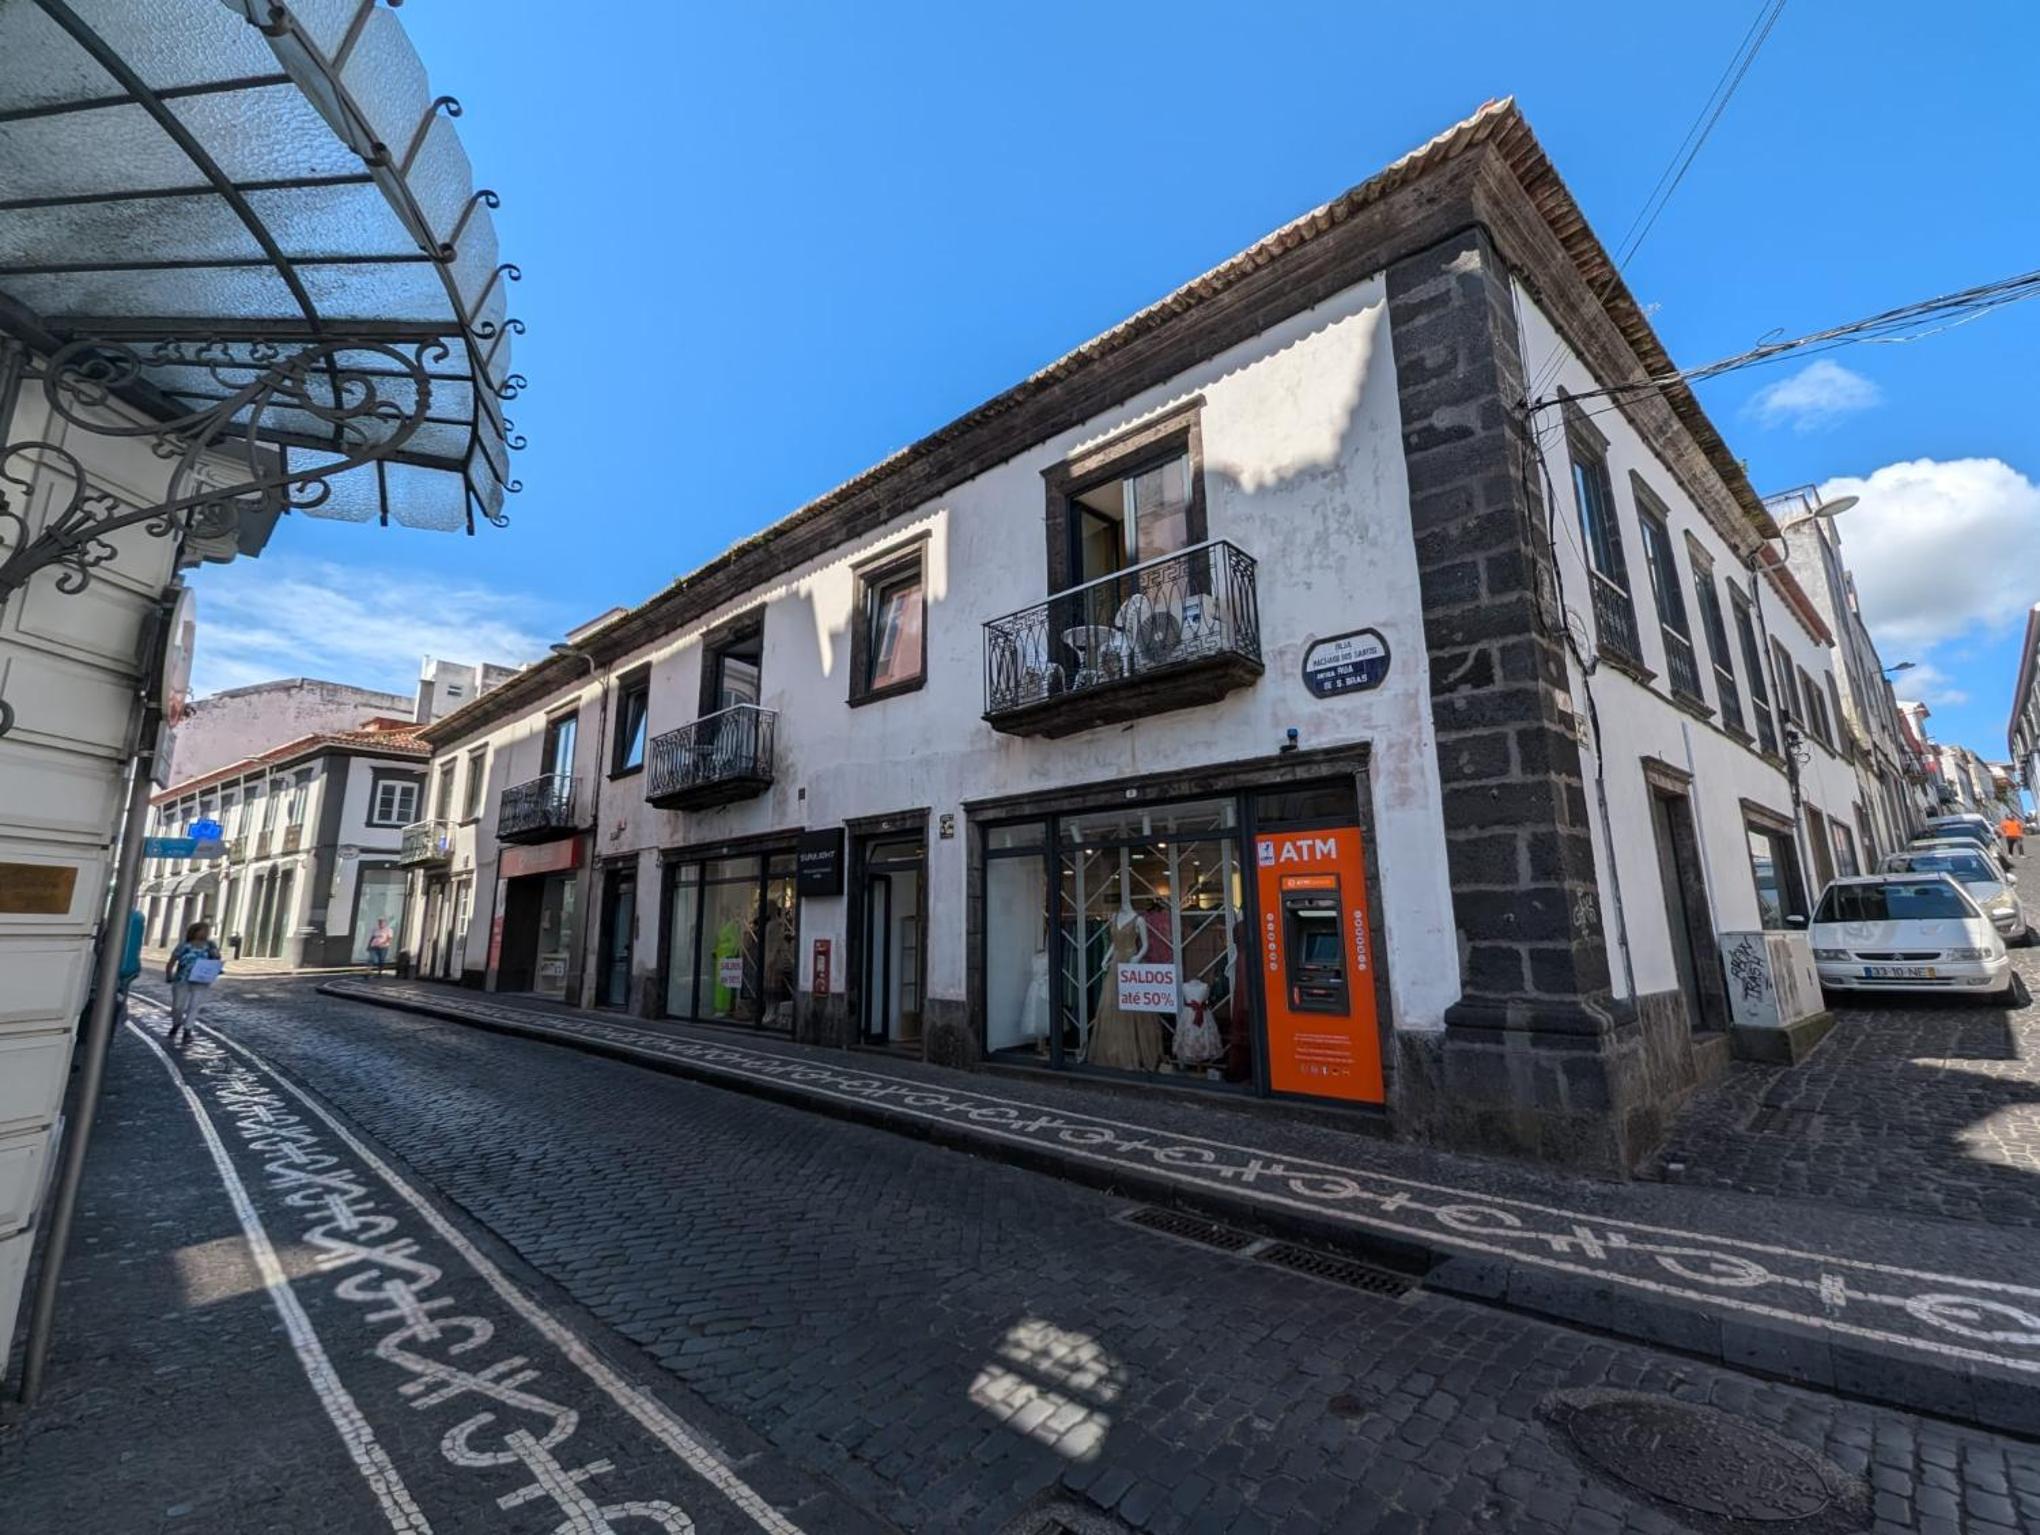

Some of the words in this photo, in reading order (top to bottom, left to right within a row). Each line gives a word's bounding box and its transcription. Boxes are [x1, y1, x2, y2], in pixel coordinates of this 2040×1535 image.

[1279, 838, 1337, 863] ATM
[1120, 969, 1173, 985] SALDOS
[1121, 990, 1141, 1005] até
[1143, 991, 1175, 1007] 50%
